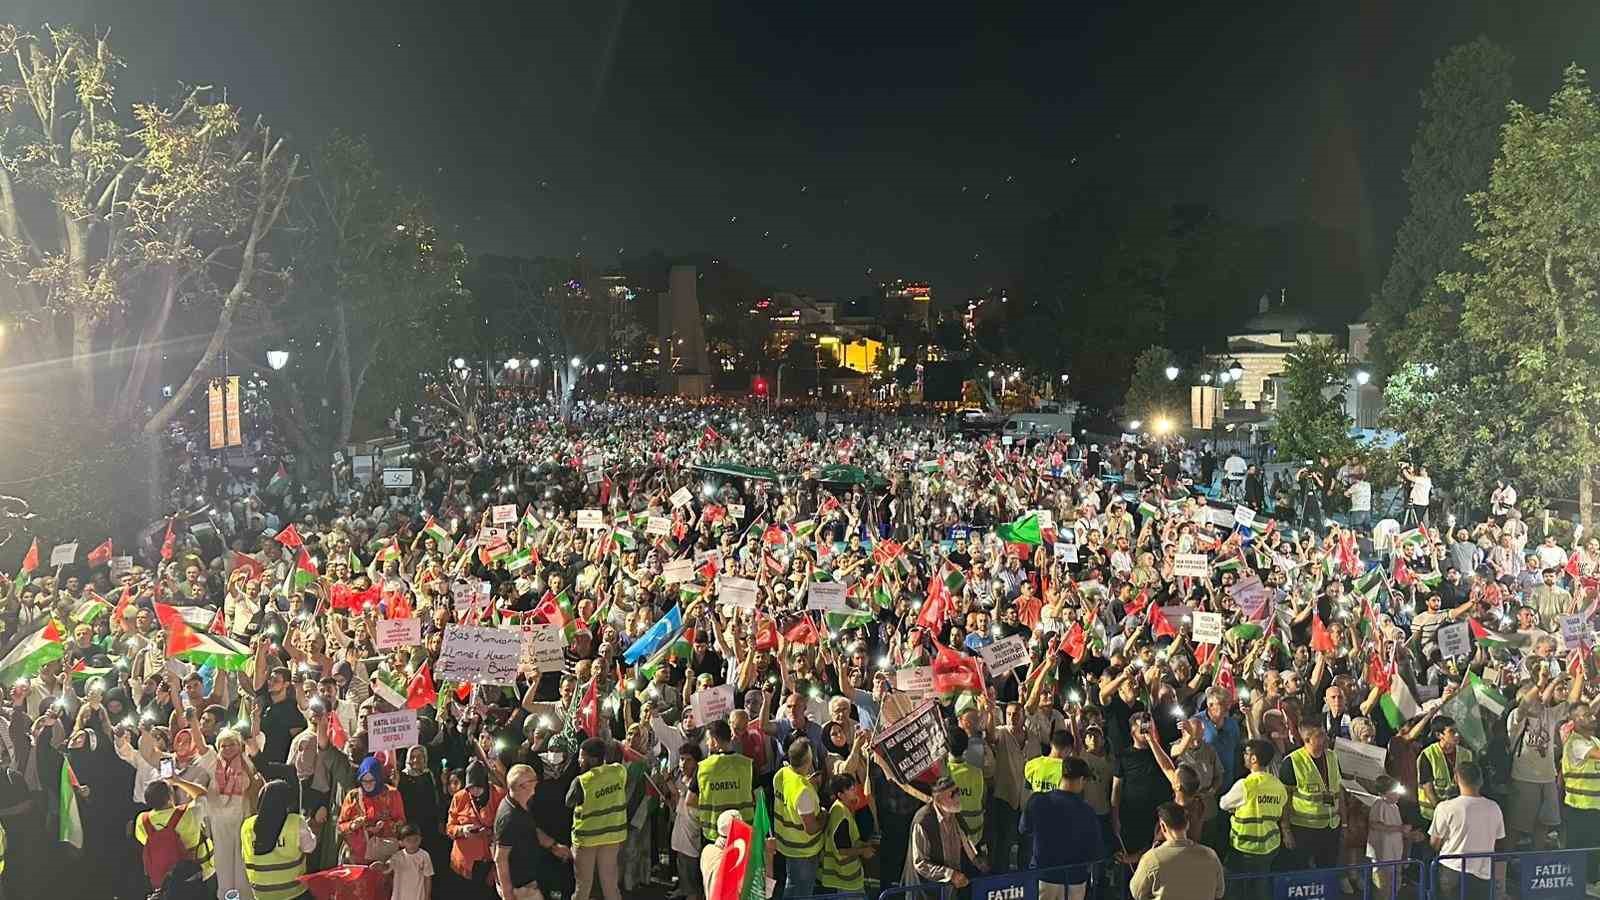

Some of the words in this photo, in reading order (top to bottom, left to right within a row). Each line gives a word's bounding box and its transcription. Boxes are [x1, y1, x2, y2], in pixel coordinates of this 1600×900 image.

[903, 740, 913, 751] SU
[910, 728, 929, 746] DÖKSE
[987, 884, 1024, 900] FATİH
[1287, 882, 1325, 897] FATİH
